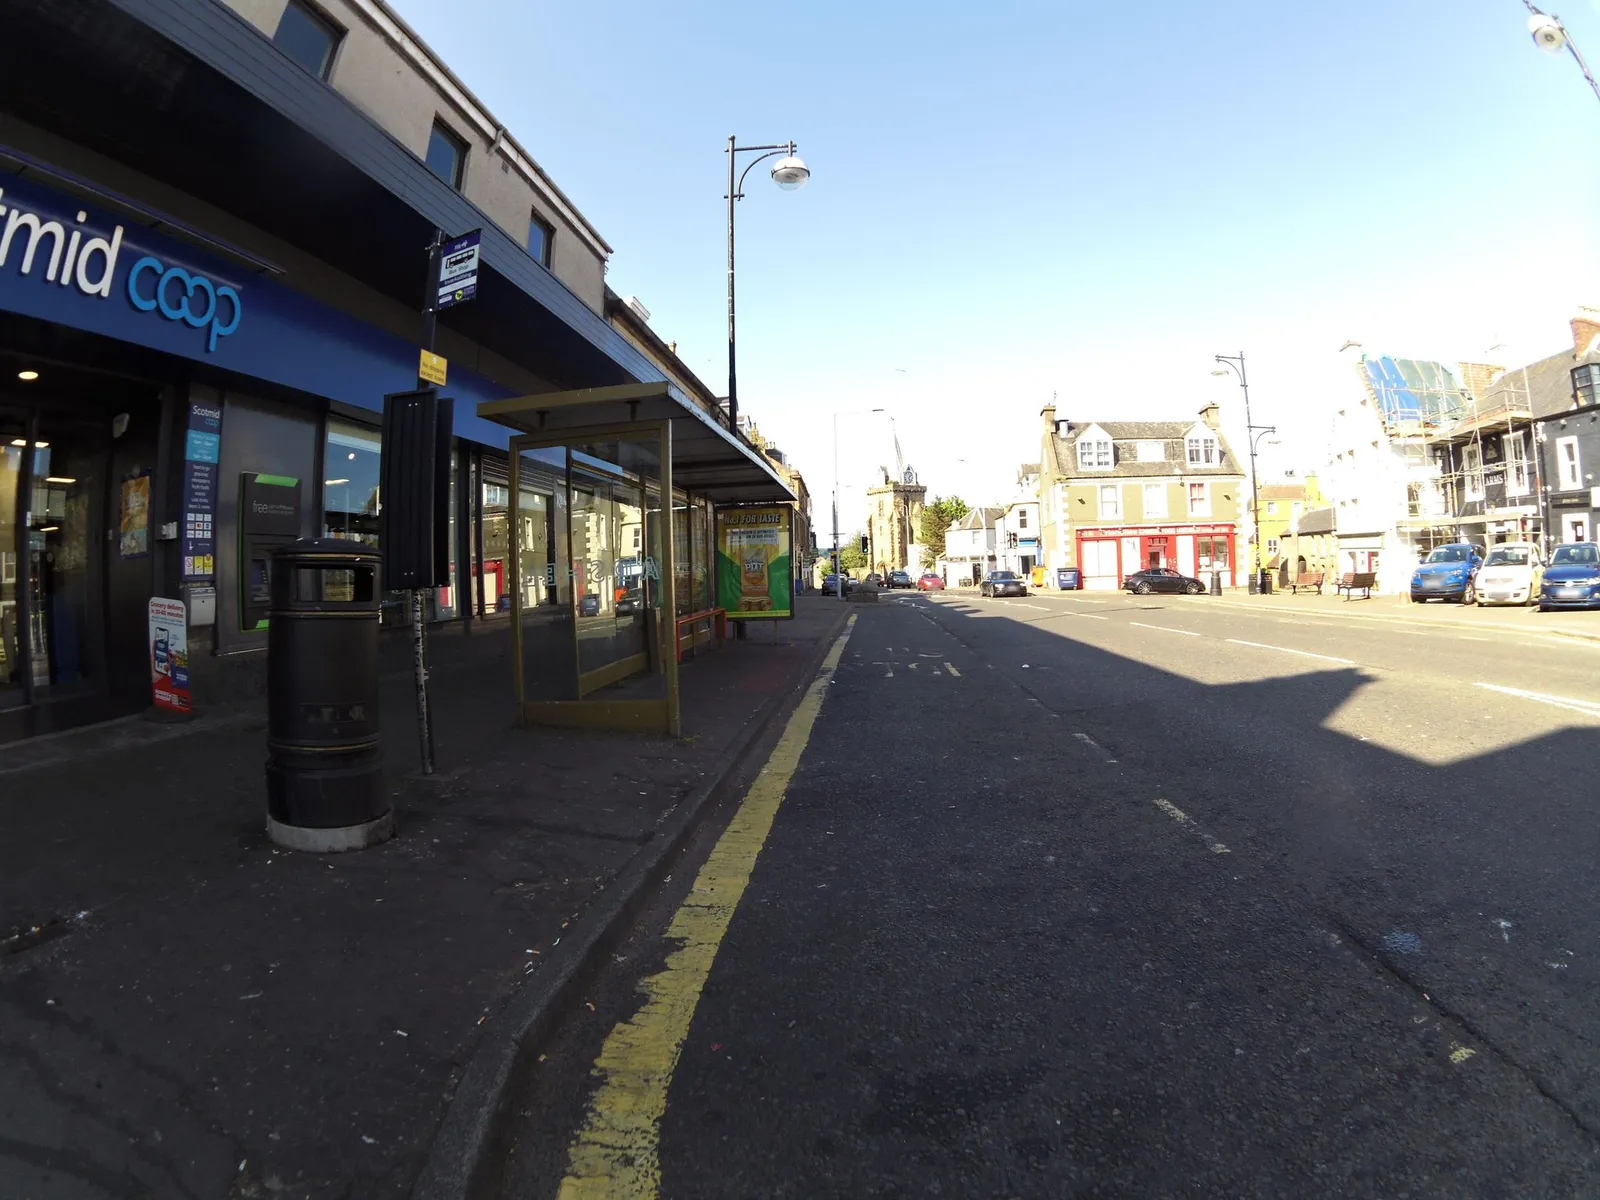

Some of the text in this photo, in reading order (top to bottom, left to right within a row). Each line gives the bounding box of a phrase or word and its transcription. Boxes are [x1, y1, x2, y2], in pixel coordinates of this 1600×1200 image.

[129, 256, 242, 352] coop
[193, 405, 220, 418] Scotmid
[252, 500, 269, 514] free
[741, 514, 757, 524] FOR
[759, 513, 781, 524] TASTE
